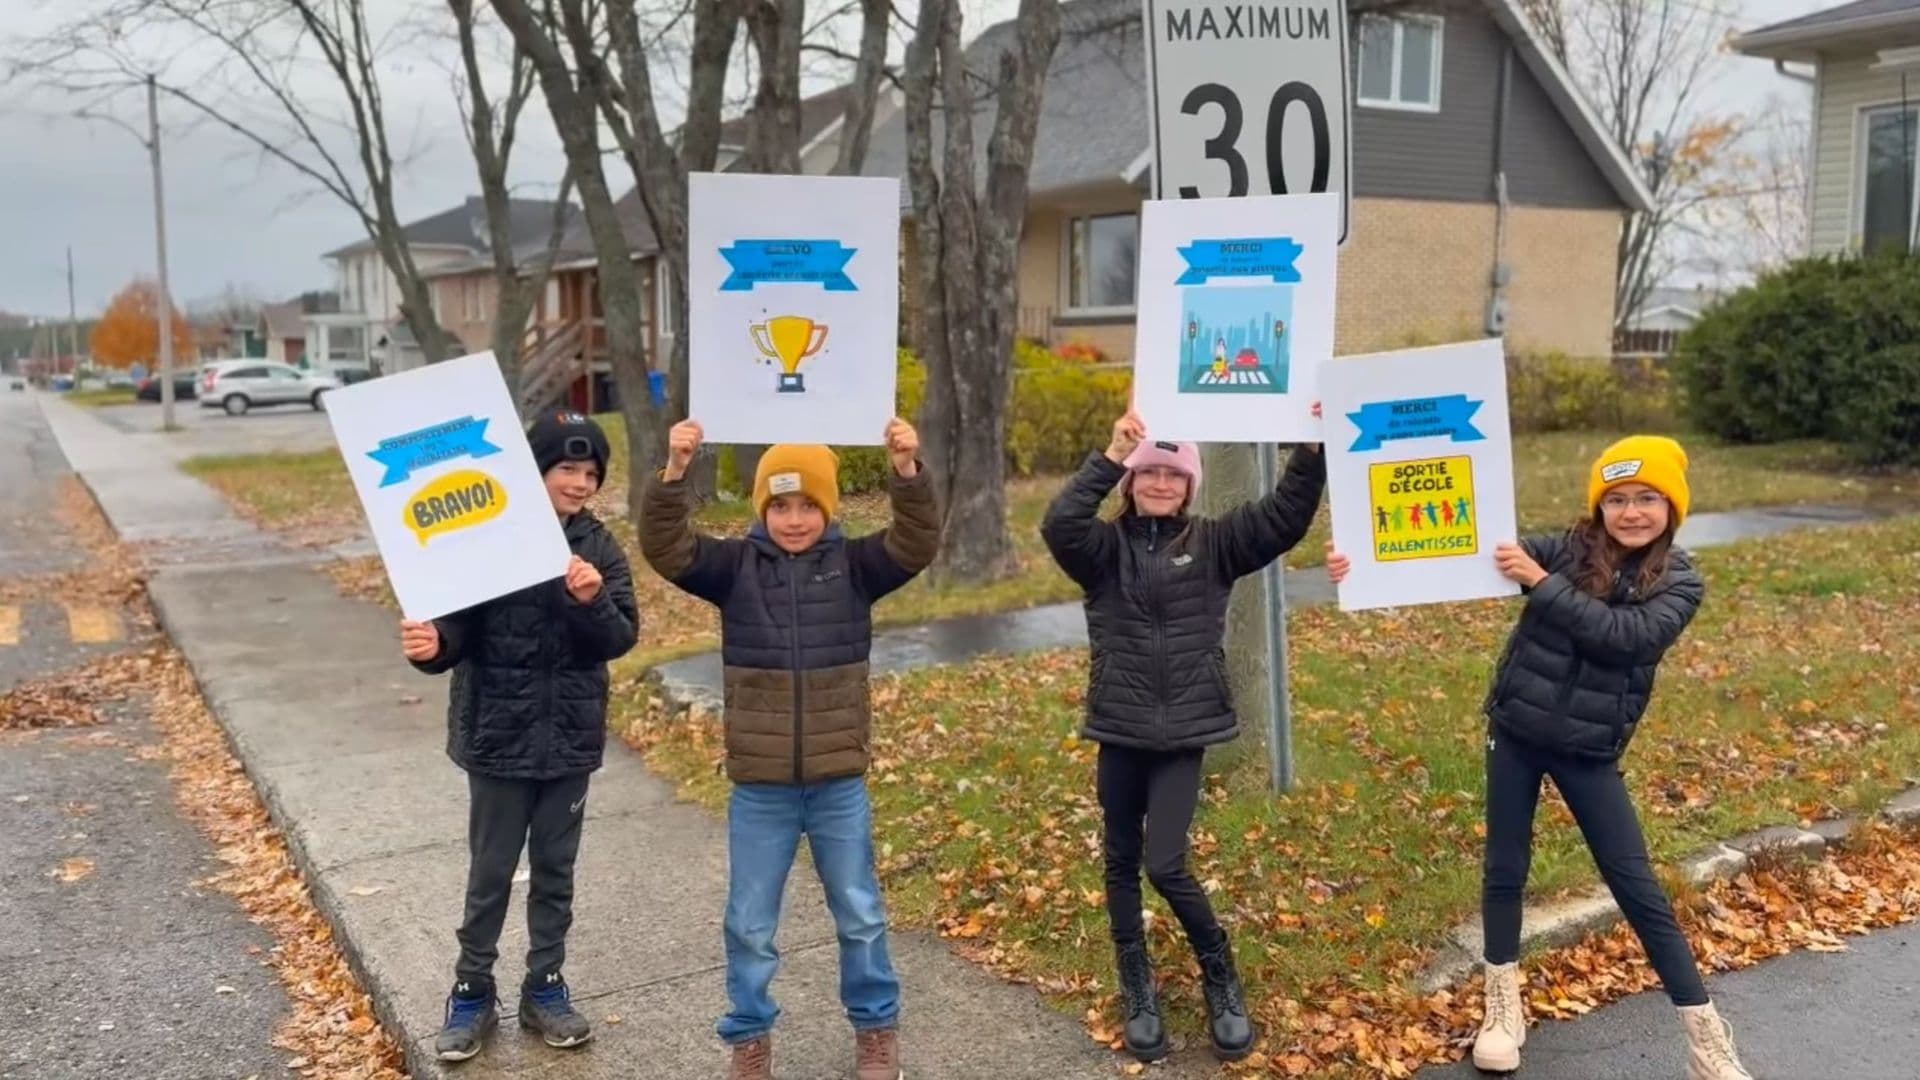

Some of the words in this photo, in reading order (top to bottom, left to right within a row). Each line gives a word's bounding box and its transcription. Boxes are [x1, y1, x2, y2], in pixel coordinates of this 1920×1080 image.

[1166, 5, 1330, 42] MAXIMUM
[1179, 81, 1331, 199] 30
[1220, 241, 1263, 254] MERCI
[1391, 400, 1437, 415] MERCI
[1394, 461, 1447, 479] SORTIE
[412, 479, 495, 529] BRAVO!
[1379, 535, 1473, 555] RALENTISSEZ
